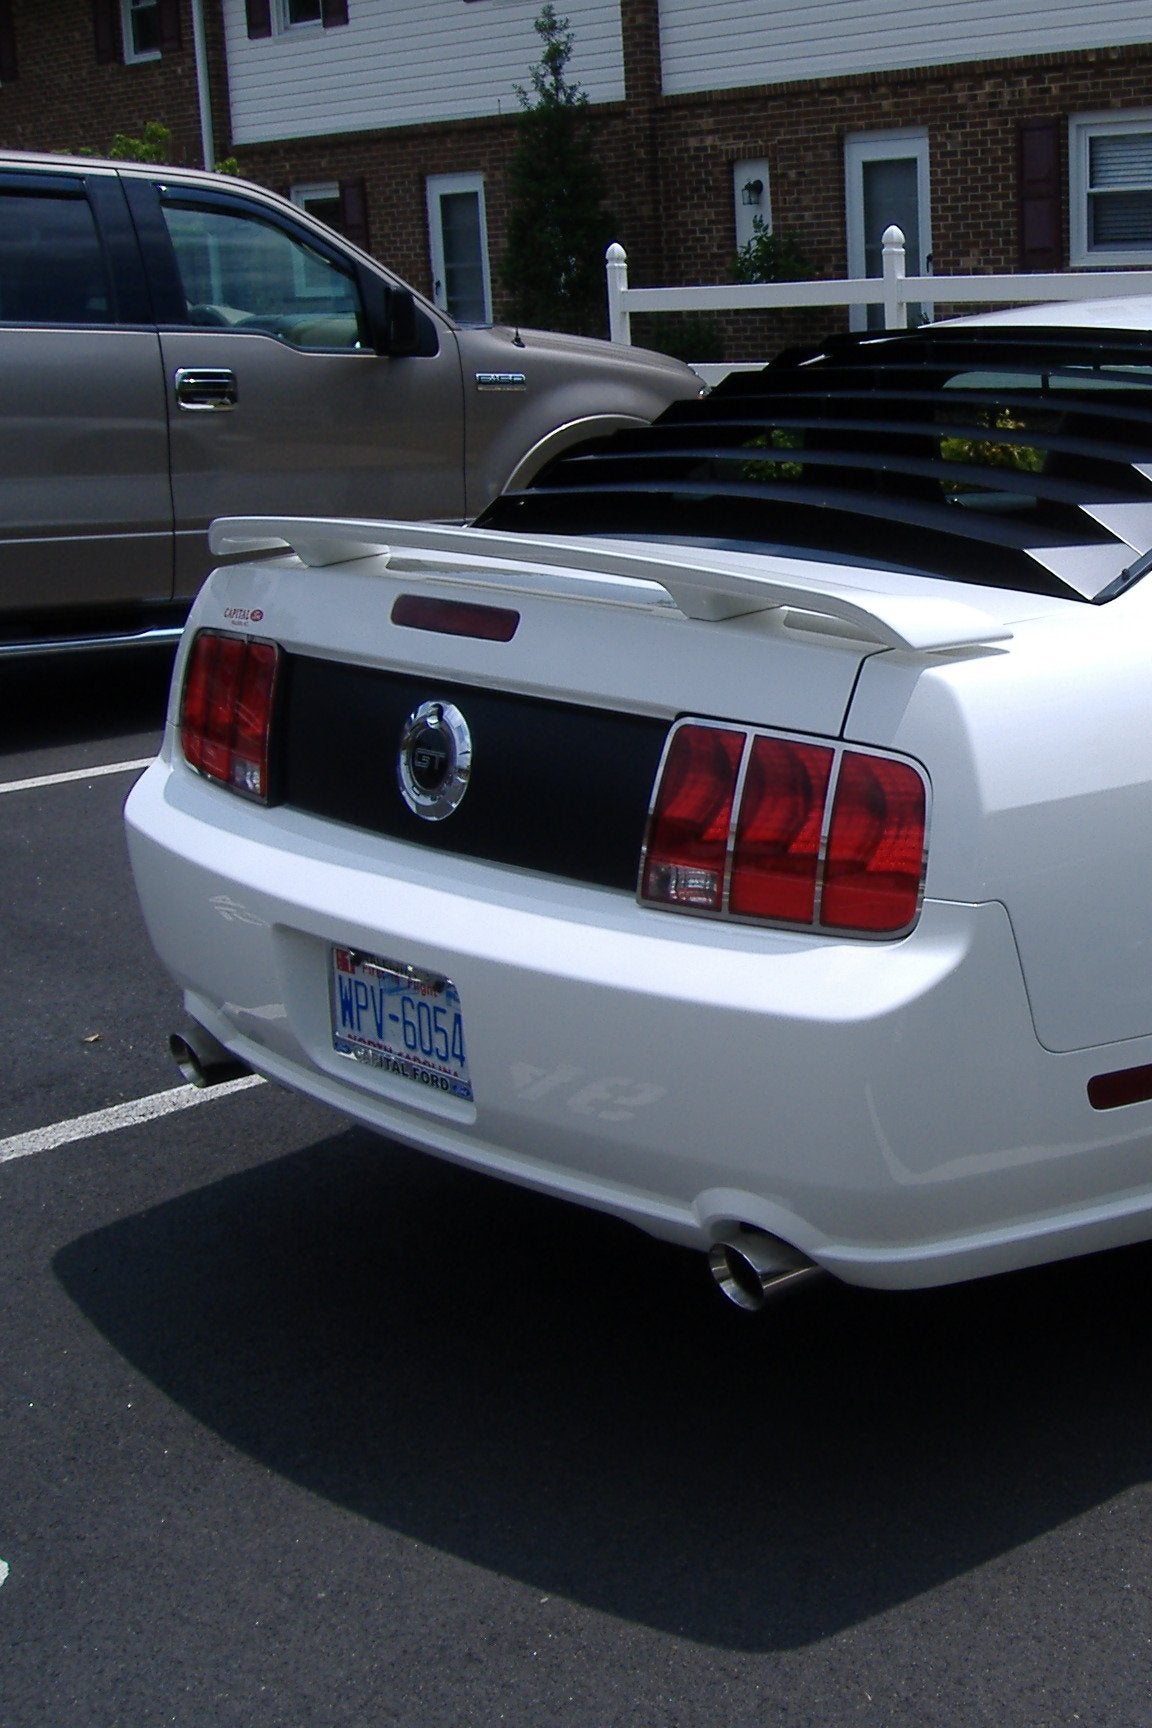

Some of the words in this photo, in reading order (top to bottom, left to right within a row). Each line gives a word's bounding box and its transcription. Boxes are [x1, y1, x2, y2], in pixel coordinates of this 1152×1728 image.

[224, 608, 250, 620] CAPITAL
[338, 974, 466, 1068] WPV-6054
[355, 1048, 409, 1077] ITAL
[413, 1067, 449, 1090] FORD
